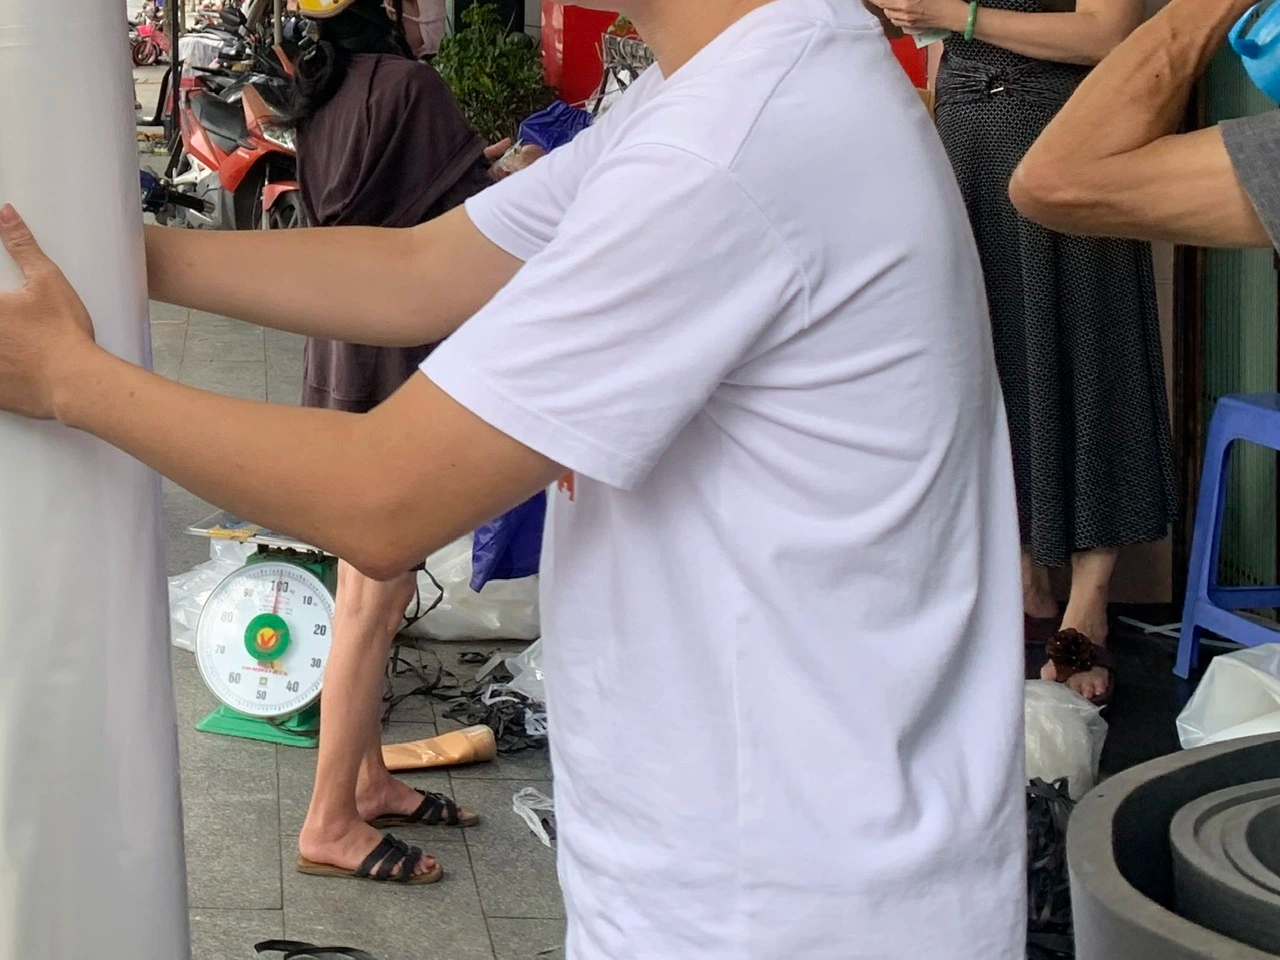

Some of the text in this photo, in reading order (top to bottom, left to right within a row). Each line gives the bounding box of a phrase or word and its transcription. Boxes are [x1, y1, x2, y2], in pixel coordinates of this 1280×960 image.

[303, 595, 313, 606] 10
[313, 624, 327, 637] 20
[310, 658, 322, 669] 30
[228, 672, 241, 684] 60
[286, 681, 300, 693] 40
[256, 690, 267, 701] 50
